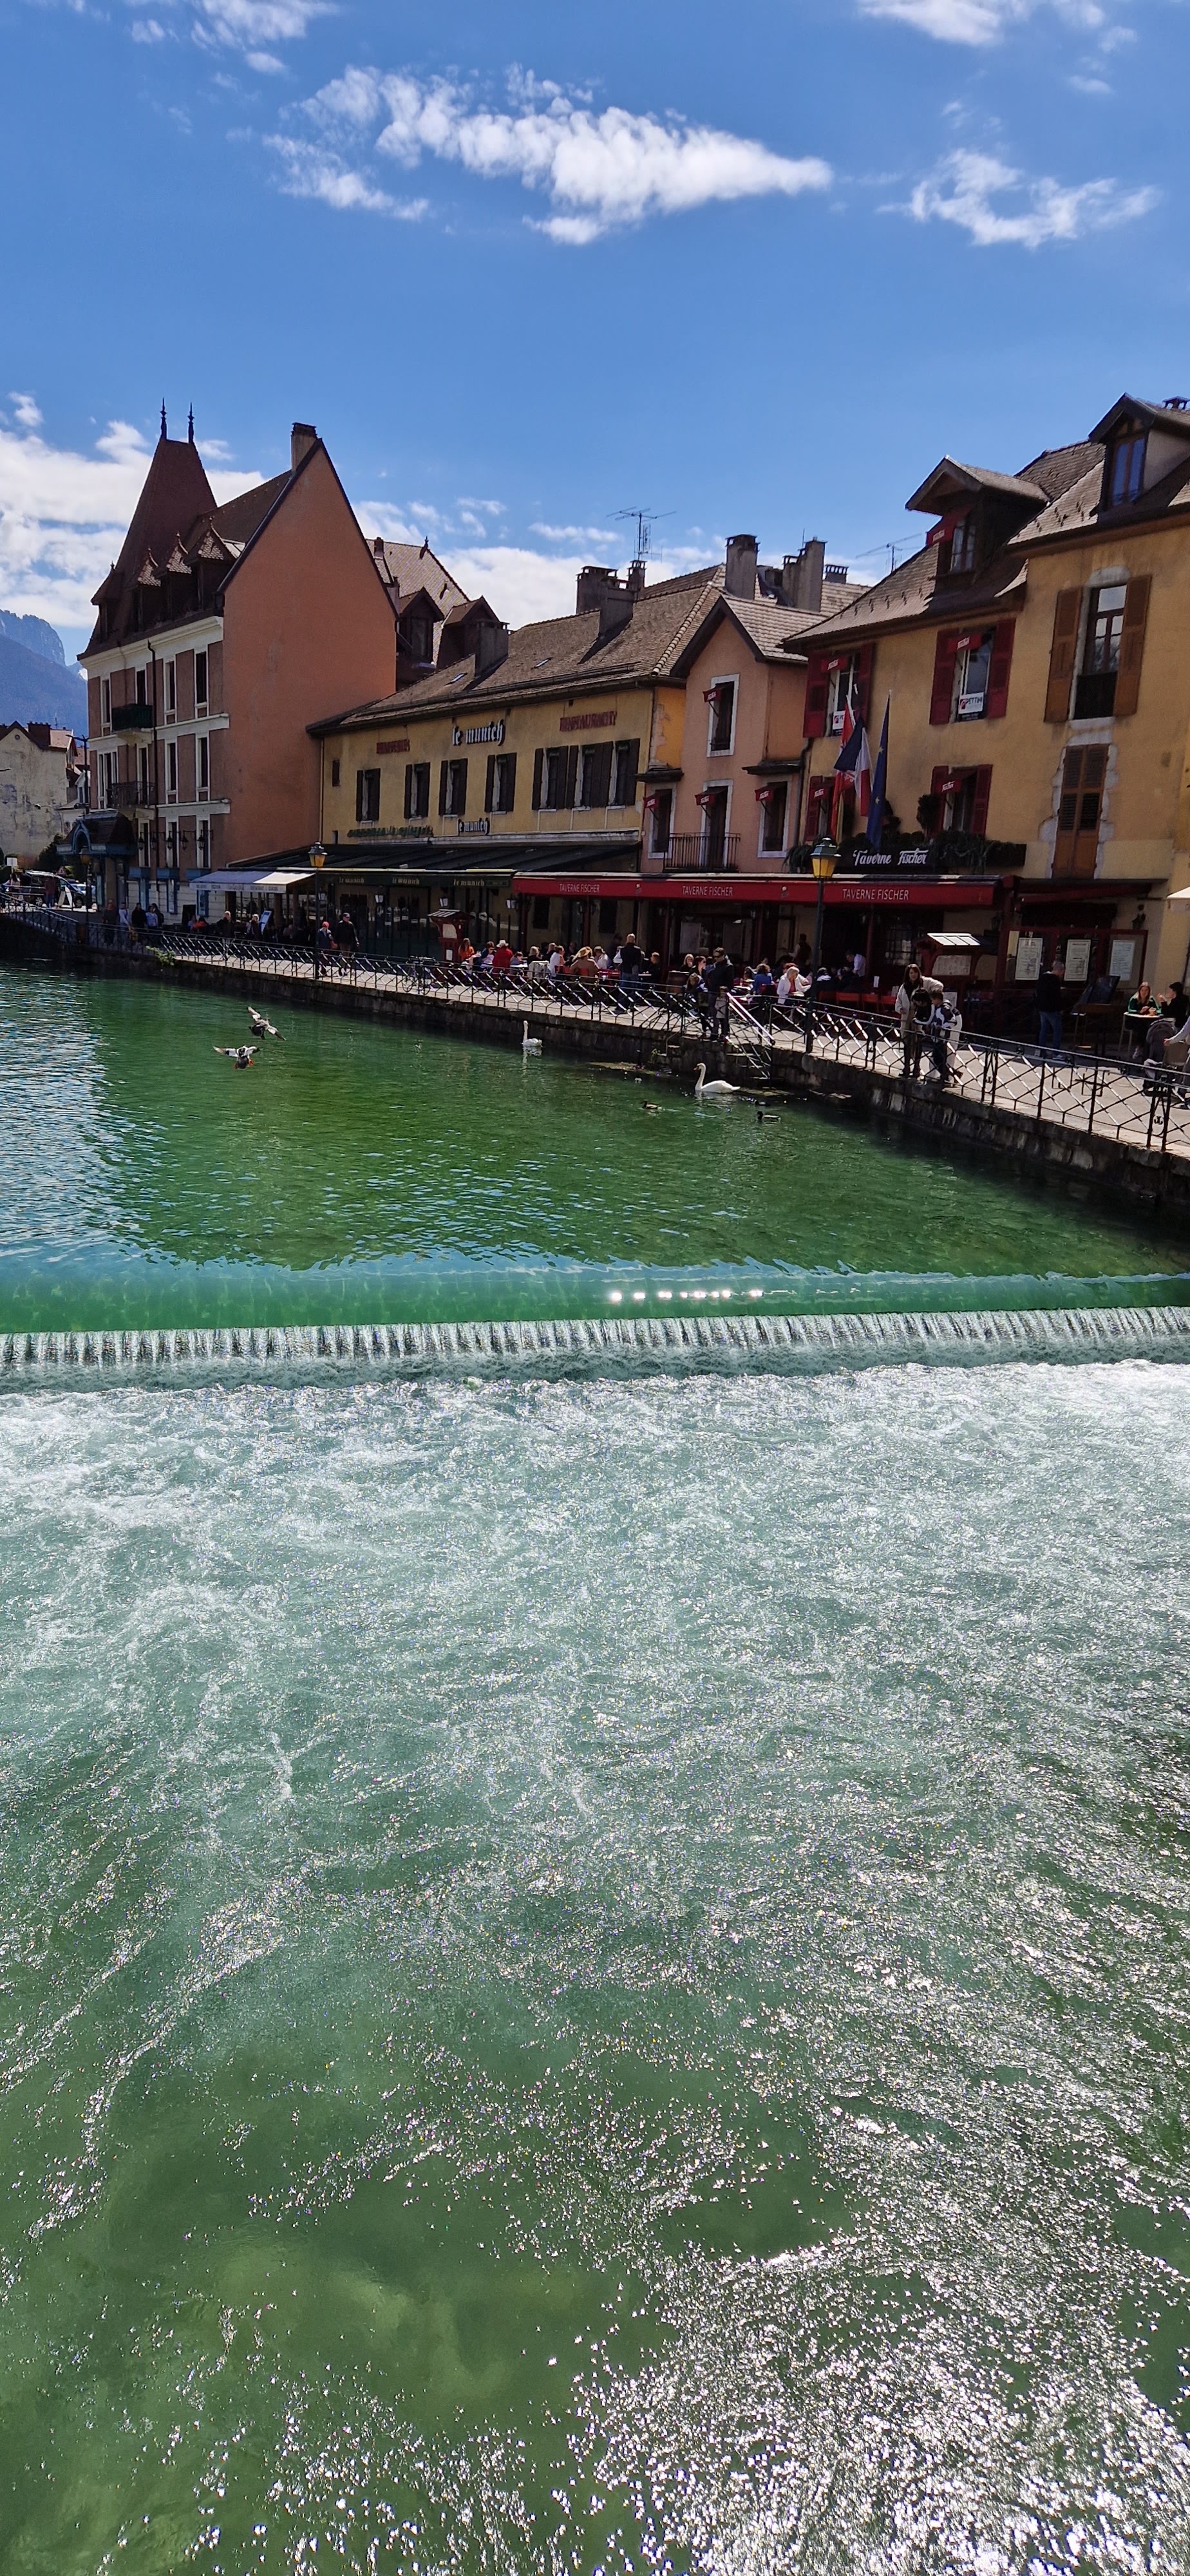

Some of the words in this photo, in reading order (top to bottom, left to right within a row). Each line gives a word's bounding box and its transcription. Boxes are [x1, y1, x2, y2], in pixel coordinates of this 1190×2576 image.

[465, 719, 505, 746] munich
[853, 849, 892, 866] Taverne
[897, 848, 929, 866] Fischer
[559, 884, 580, 893] TAVERNE
[580, 884, 600, 893] FISCHER
[682, 886, 708, 896] TAVERNE
[708, 886, 733, 896] FISCHER
[842, 888, 875, 900] TAVERNE
[877, 889, 909, 900] FISCHER
